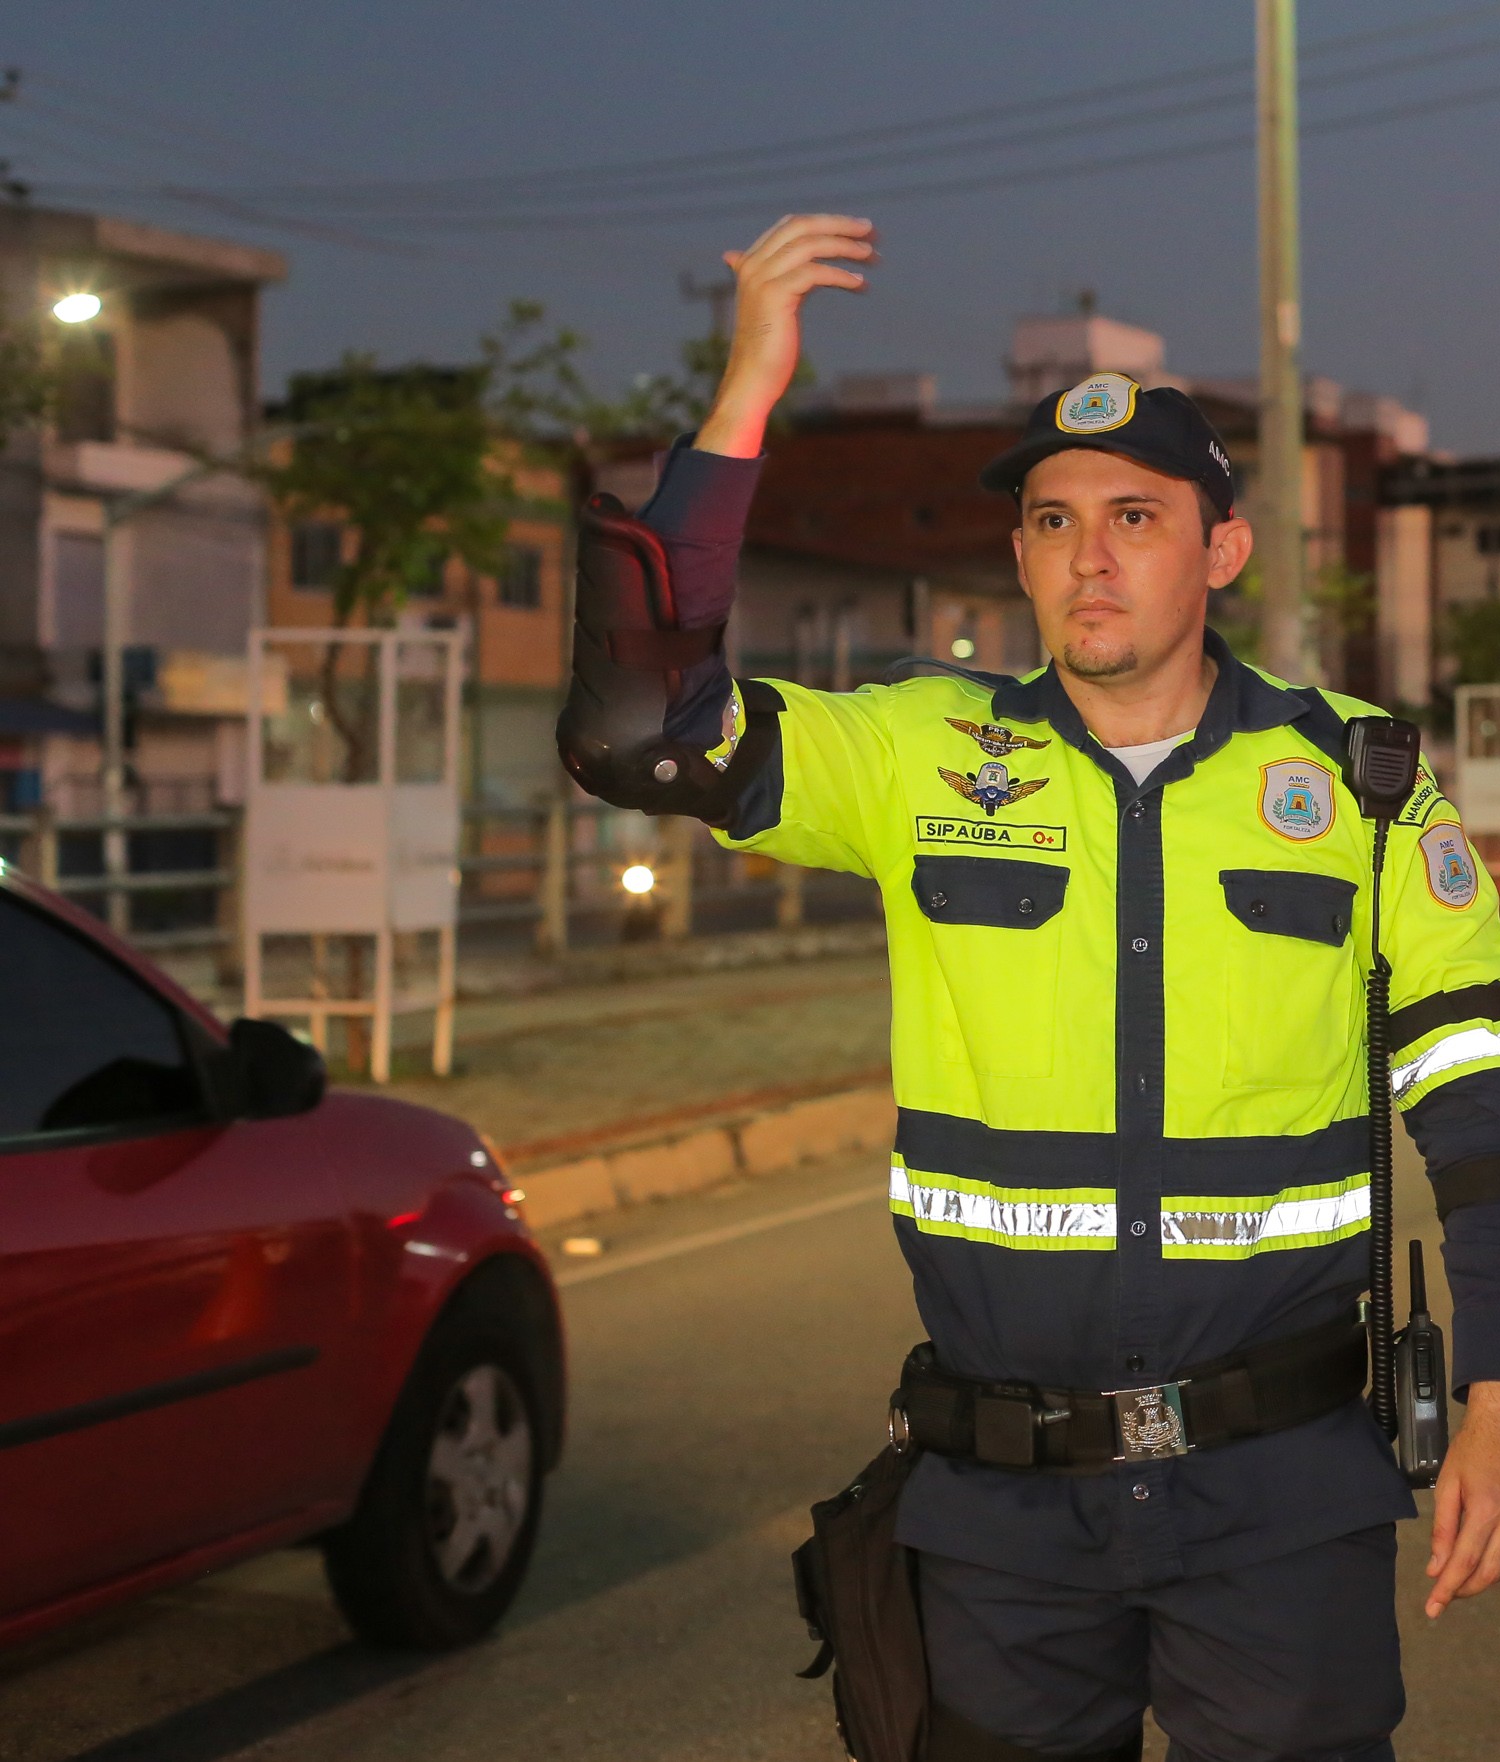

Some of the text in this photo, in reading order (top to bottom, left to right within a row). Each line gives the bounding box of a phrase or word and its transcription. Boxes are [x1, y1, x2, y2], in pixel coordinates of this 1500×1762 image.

[1209, 440, 1230, 477] AMC
[1288, 776, 1310, 784] AMC
[926, 822, 1011, 842] SIPAÚBA
[1440, 839, 1454, 850] AMC
